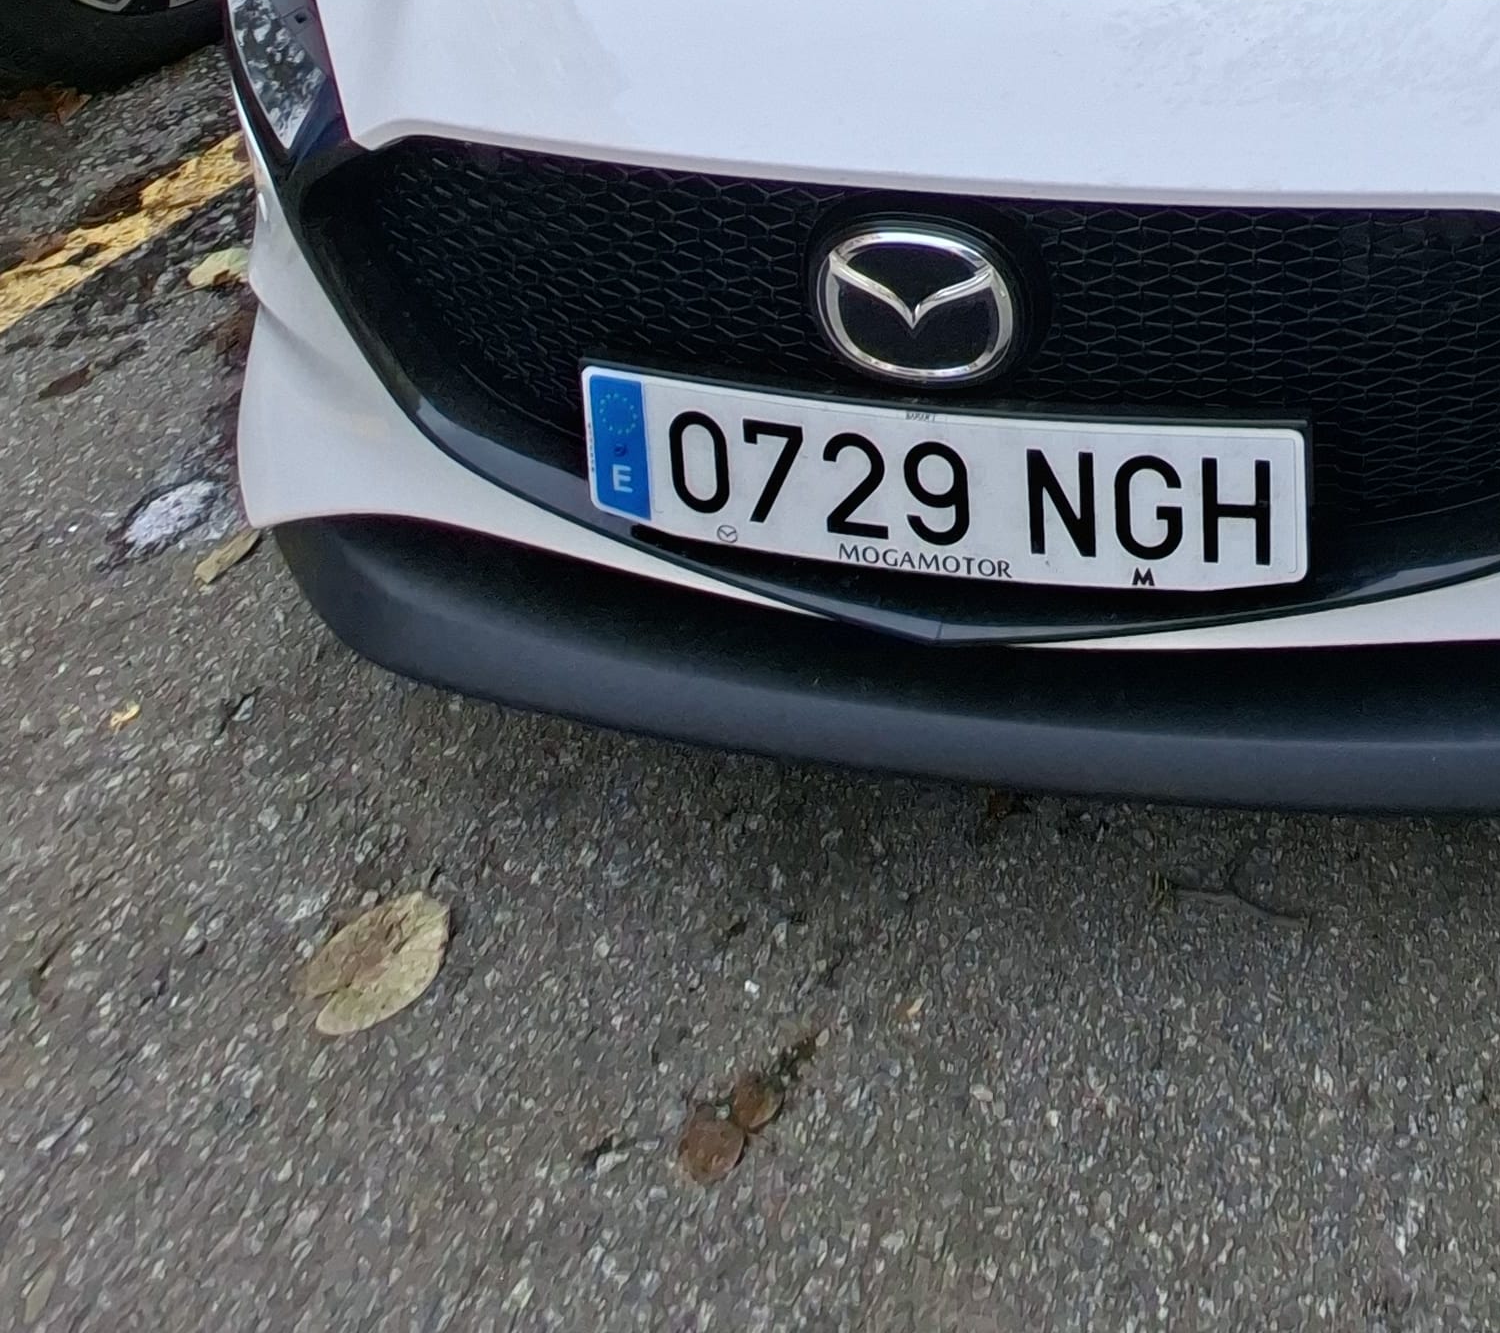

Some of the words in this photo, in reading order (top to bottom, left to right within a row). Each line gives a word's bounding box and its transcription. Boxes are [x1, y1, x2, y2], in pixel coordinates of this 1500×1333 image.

[612, 464, 632, 493] E
[668, 410, 969, 546] 0729
[1027, 448, 1271, 565] NGH
[838, 542, 1013, 580] MOGAMOTOR
